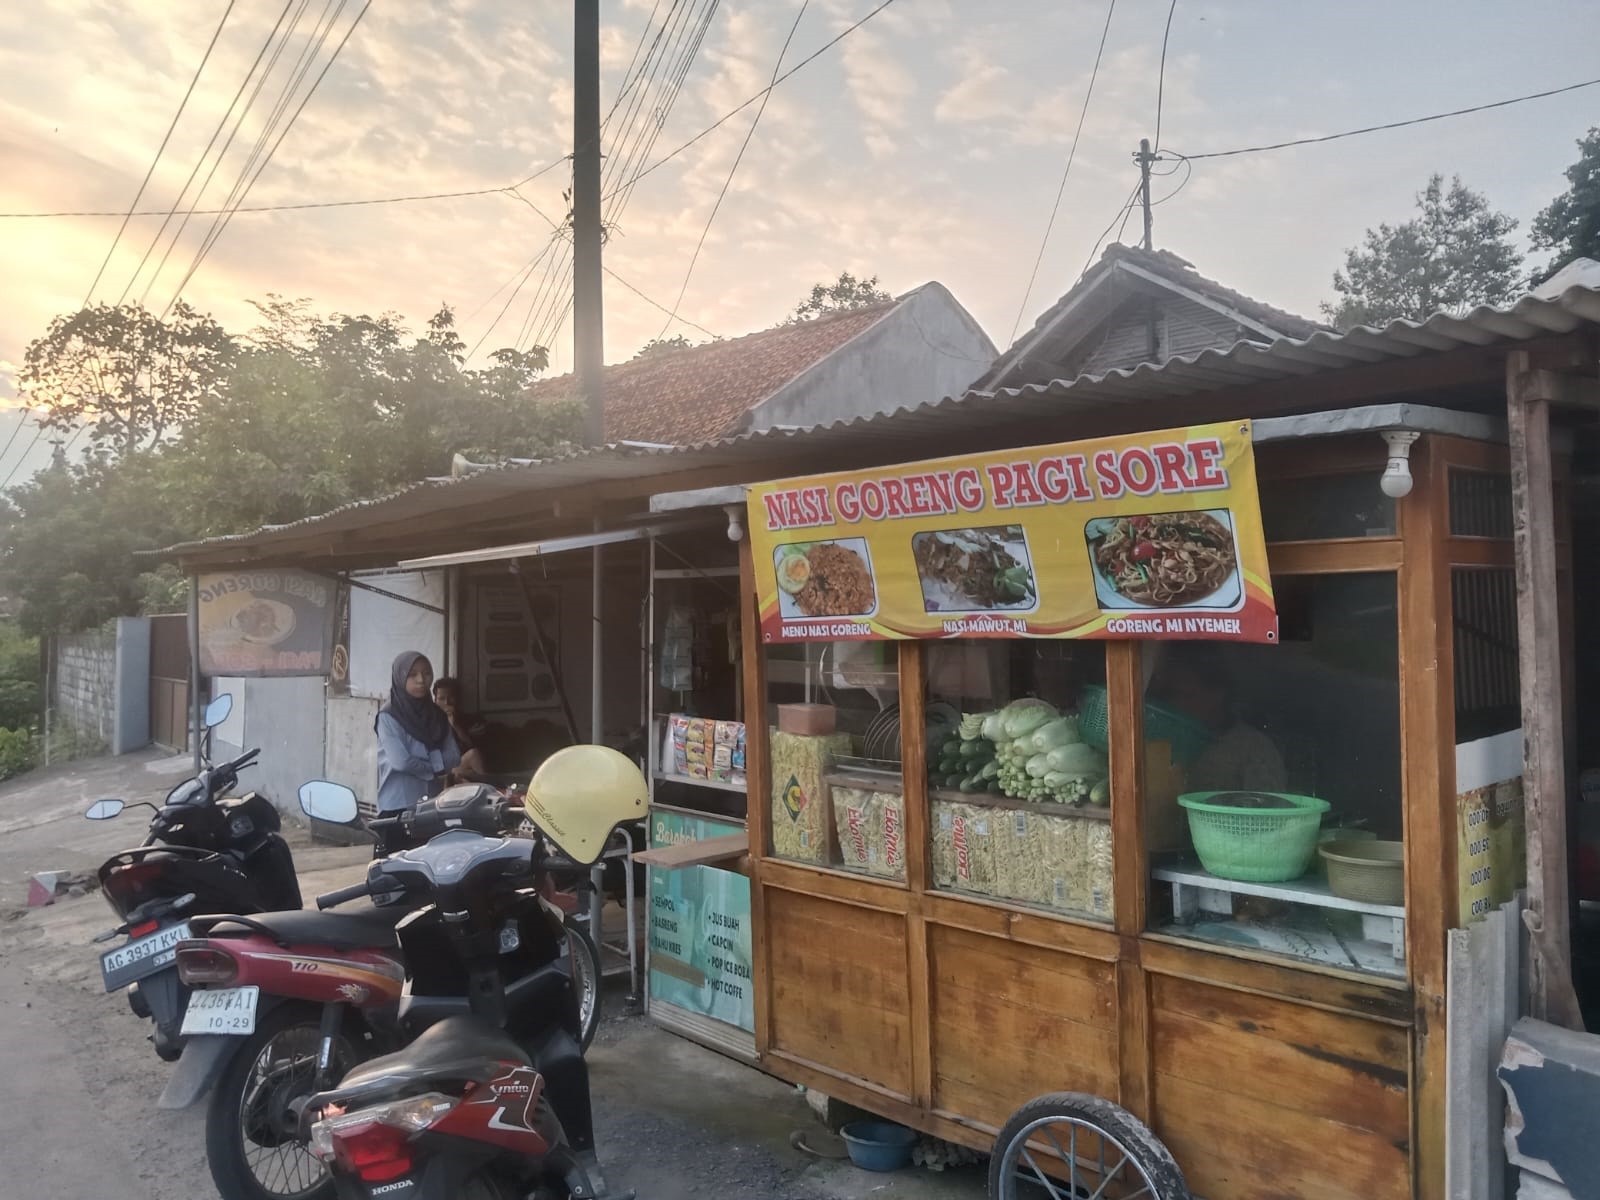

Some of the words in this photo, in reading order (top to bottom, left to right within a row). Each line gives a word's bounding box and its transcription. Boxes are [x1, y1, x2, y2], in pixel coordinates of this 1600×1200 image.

[763, 487, 836, 531] NASI
[835, 467, 985, 523] GORENG
[986, 454, 1094, 509] PAGI
[1093, 438, 1229, 498] SORE
[782, 626, 808, 638] MENU
[809, 625, 830, 637] NASI
[831, 623, 872, 635] GORENG
[1107, 619, 1163, 633] GORENG
[1166, 619, 1183, 633] MI
[1185, 619, 1241, 634] NYEMEK
[712, 911, 723, 927] JUS
[723, 915, 740, 931] BUAH
[126, 938, 158, 963] 3937
[160, 927, 188, 949] KKL
[711, 934, 734, 952] CAPCIN
[294, 962, 318, 971] 110
[711, 956, 723, 970] POP
[724, 959, 733, 974] ICE
[711, 978, 723, 993] HOT
[724, 981, 742, 999] COFFE
[372, 1179, 414, 1196] HONDA
